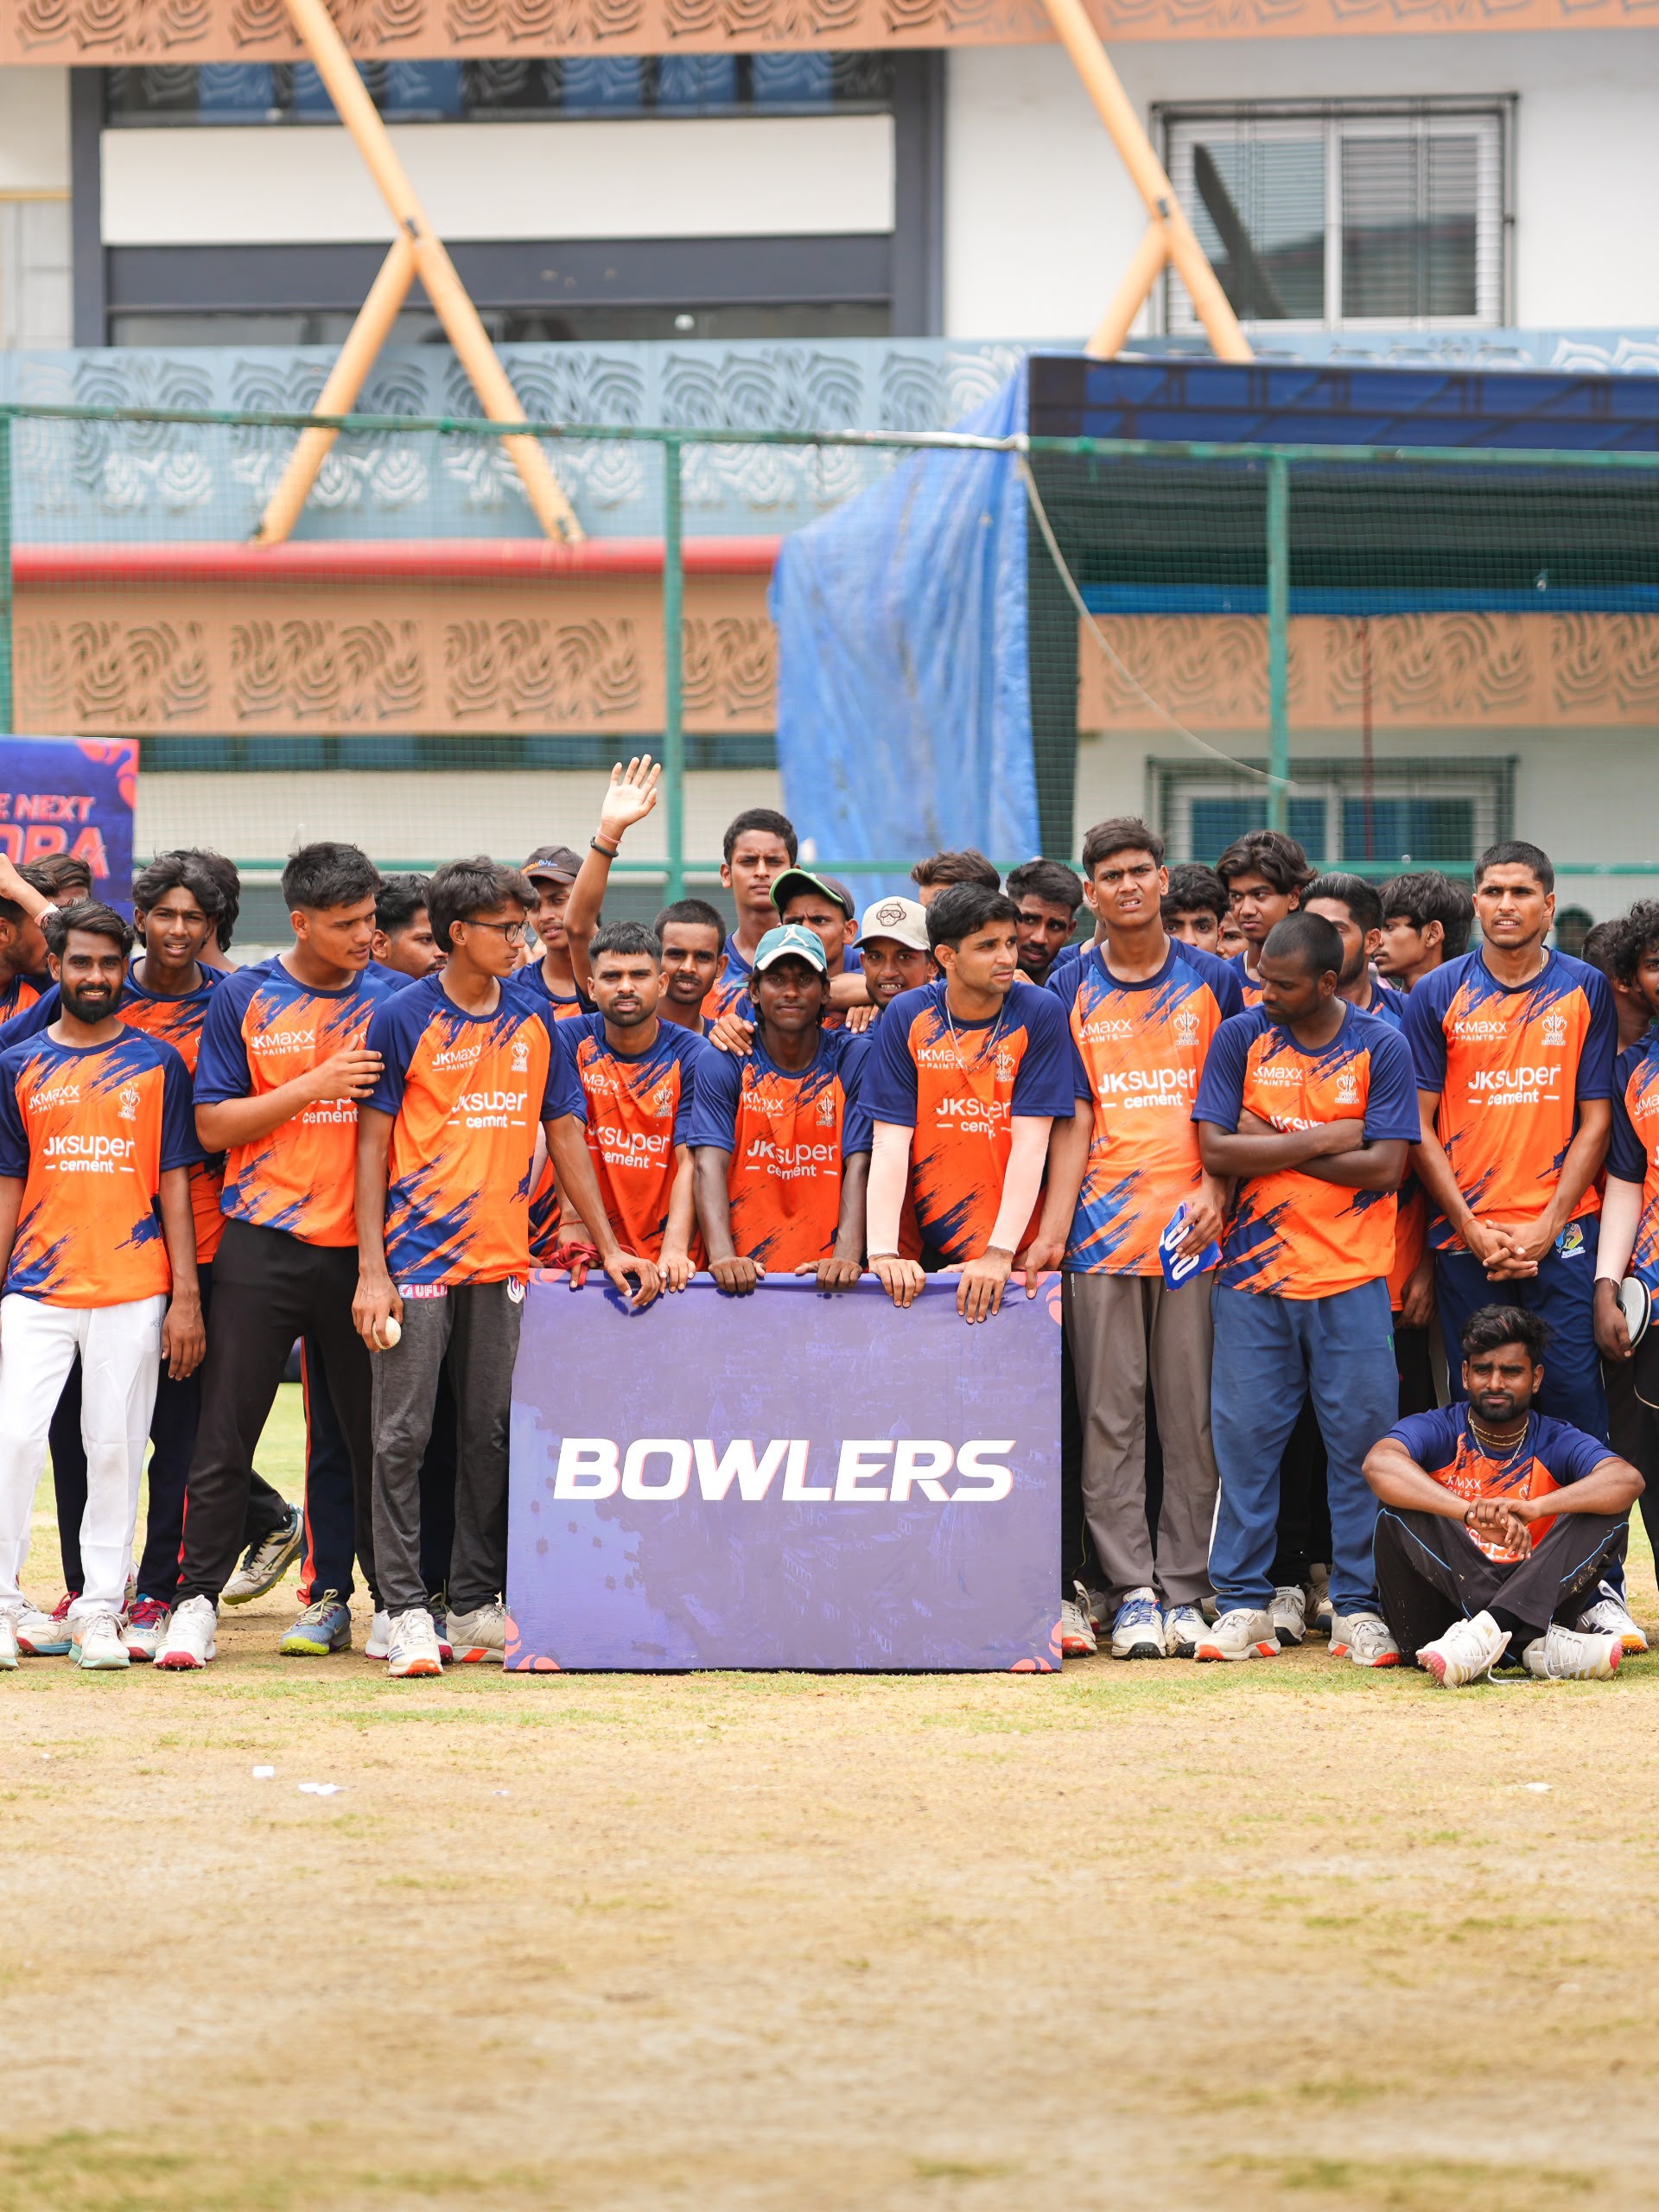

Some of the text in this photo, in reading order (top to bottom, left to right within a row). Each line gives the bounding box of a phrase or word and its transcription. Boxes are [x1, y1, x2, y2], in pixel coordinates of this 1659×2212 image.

[15, 794, 96, 823] NEXT
[262, 1045, 300, 1056] PAINTS
[1123, 1091, 1184, 1109] cement
[1488, 1090, 1539, 1106] cement
[302, 1107, 359, 1124] cement
[60, 1160, 114, 1173] cement
[767, 1164, 817, 1180] cement
[554, 1437, 1016, 1502] BOWLERS
